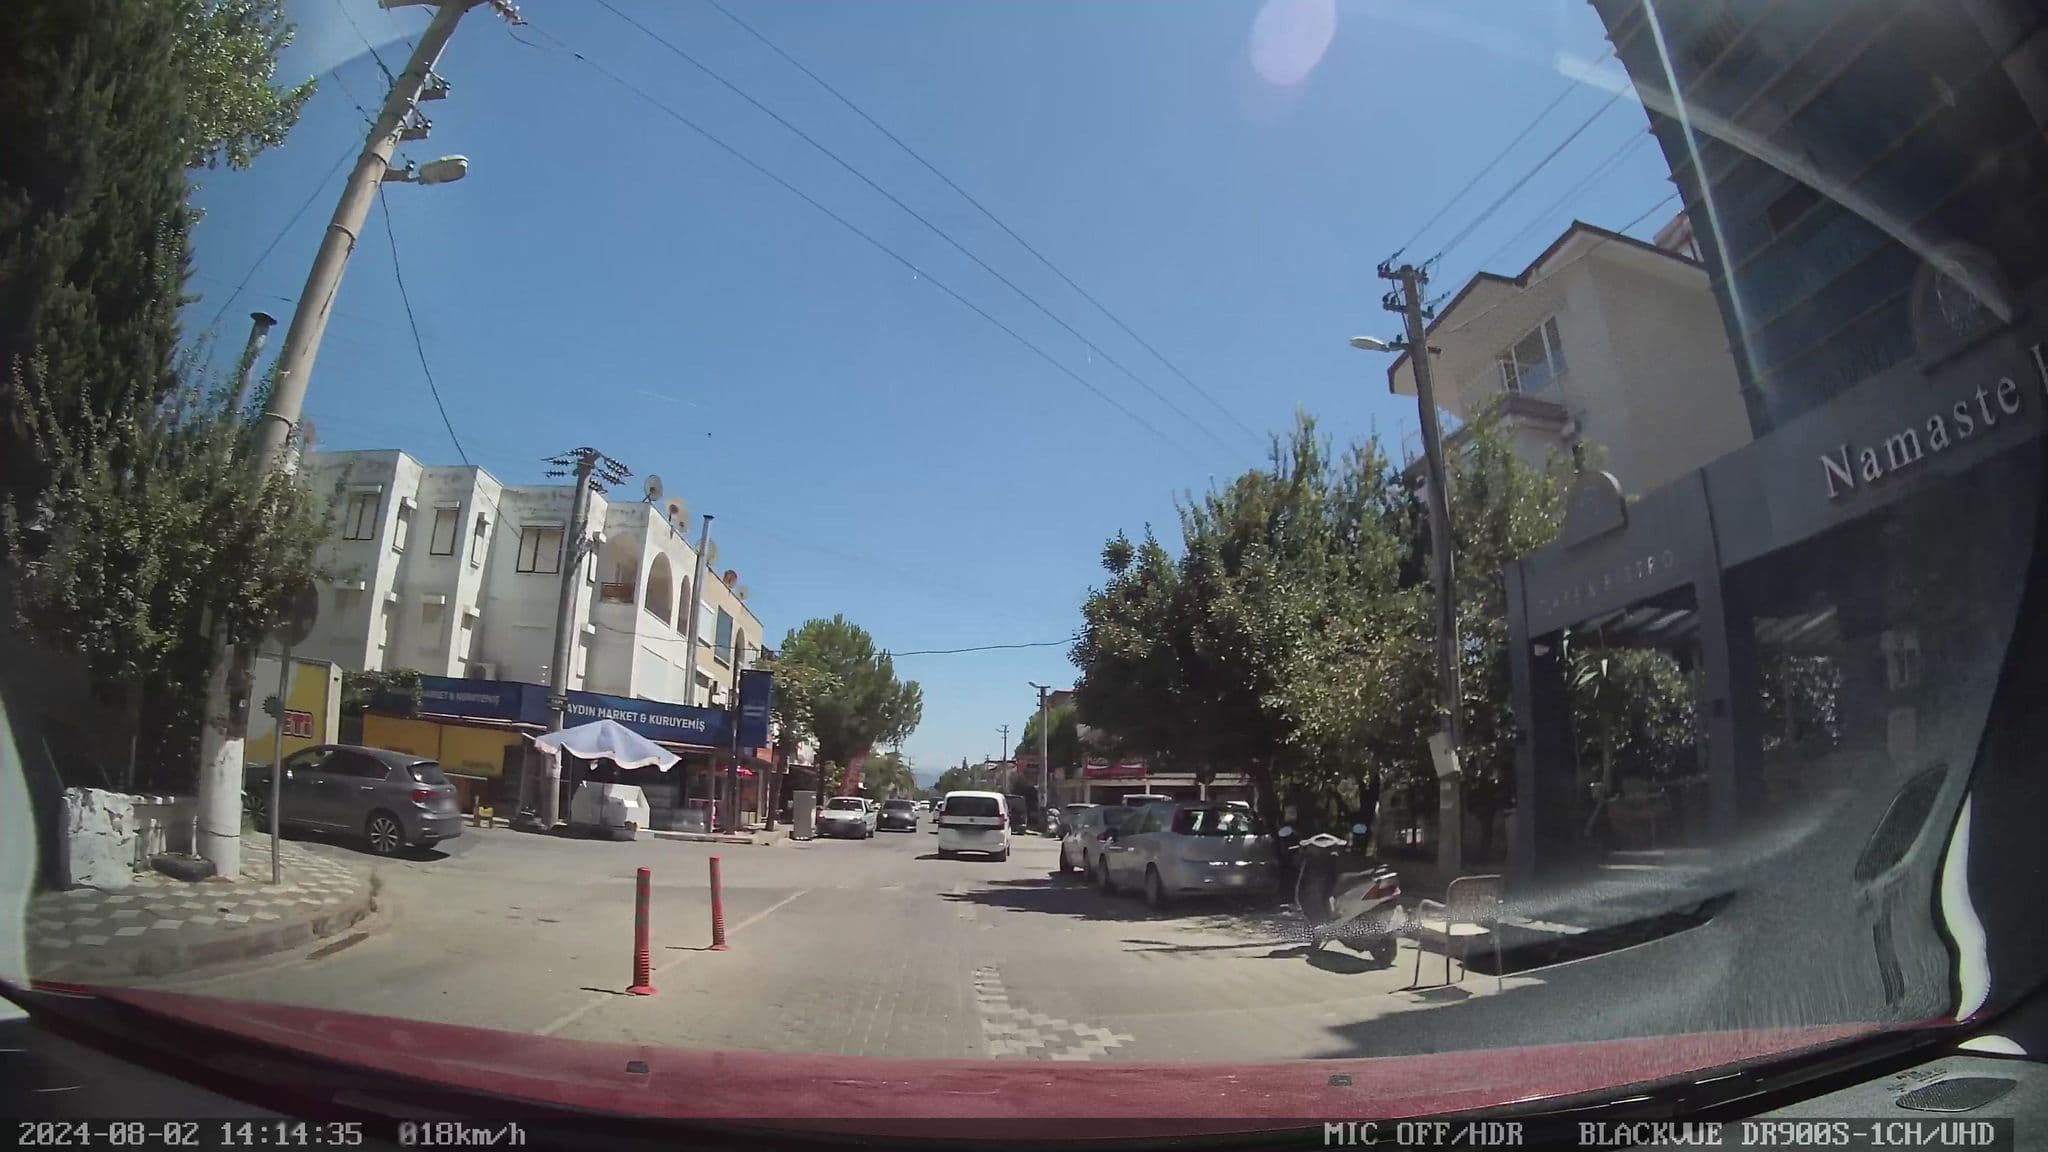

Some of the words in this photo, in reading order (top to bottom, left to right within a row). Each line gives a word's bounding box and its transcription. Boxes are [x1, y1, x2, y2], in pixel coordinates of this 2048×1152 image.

[1819, 376, 2020, 498] Namaste
[567, 703, 596, 717] AYDIN
[598, 708, 638, 722] MARKET
[640, 713, 646, 724] &
[649, 714, 706, 732] KURUYEMİŞ
